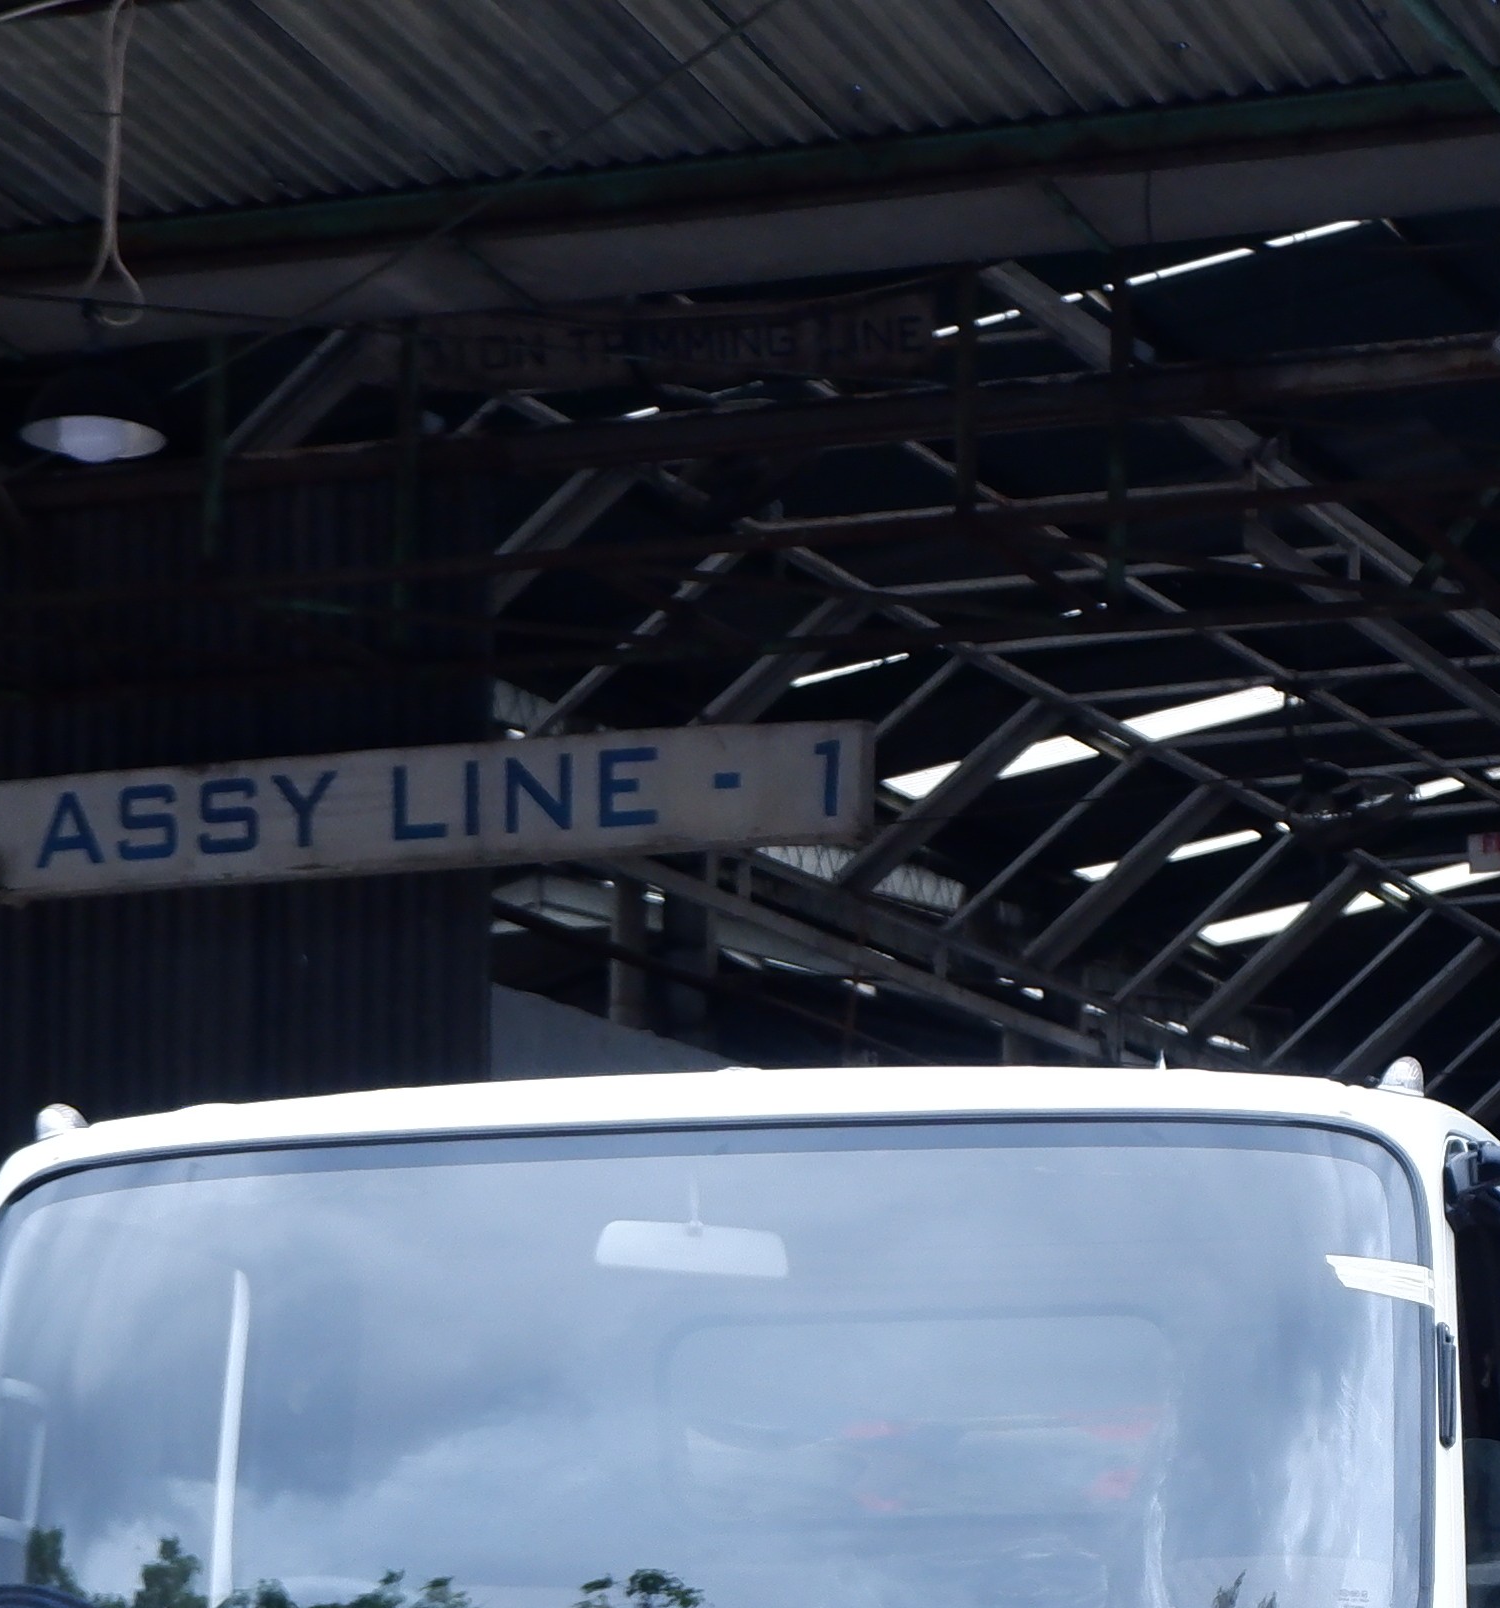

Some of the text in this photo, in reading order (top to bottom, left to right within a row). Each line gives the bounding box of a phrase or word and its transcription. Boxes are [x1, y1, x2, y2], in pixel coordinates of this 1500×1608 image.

[36, 769, 338, 870] ASSY
[391, 747, 658, 842] LINE
[812, 739, 841, 817] 1
